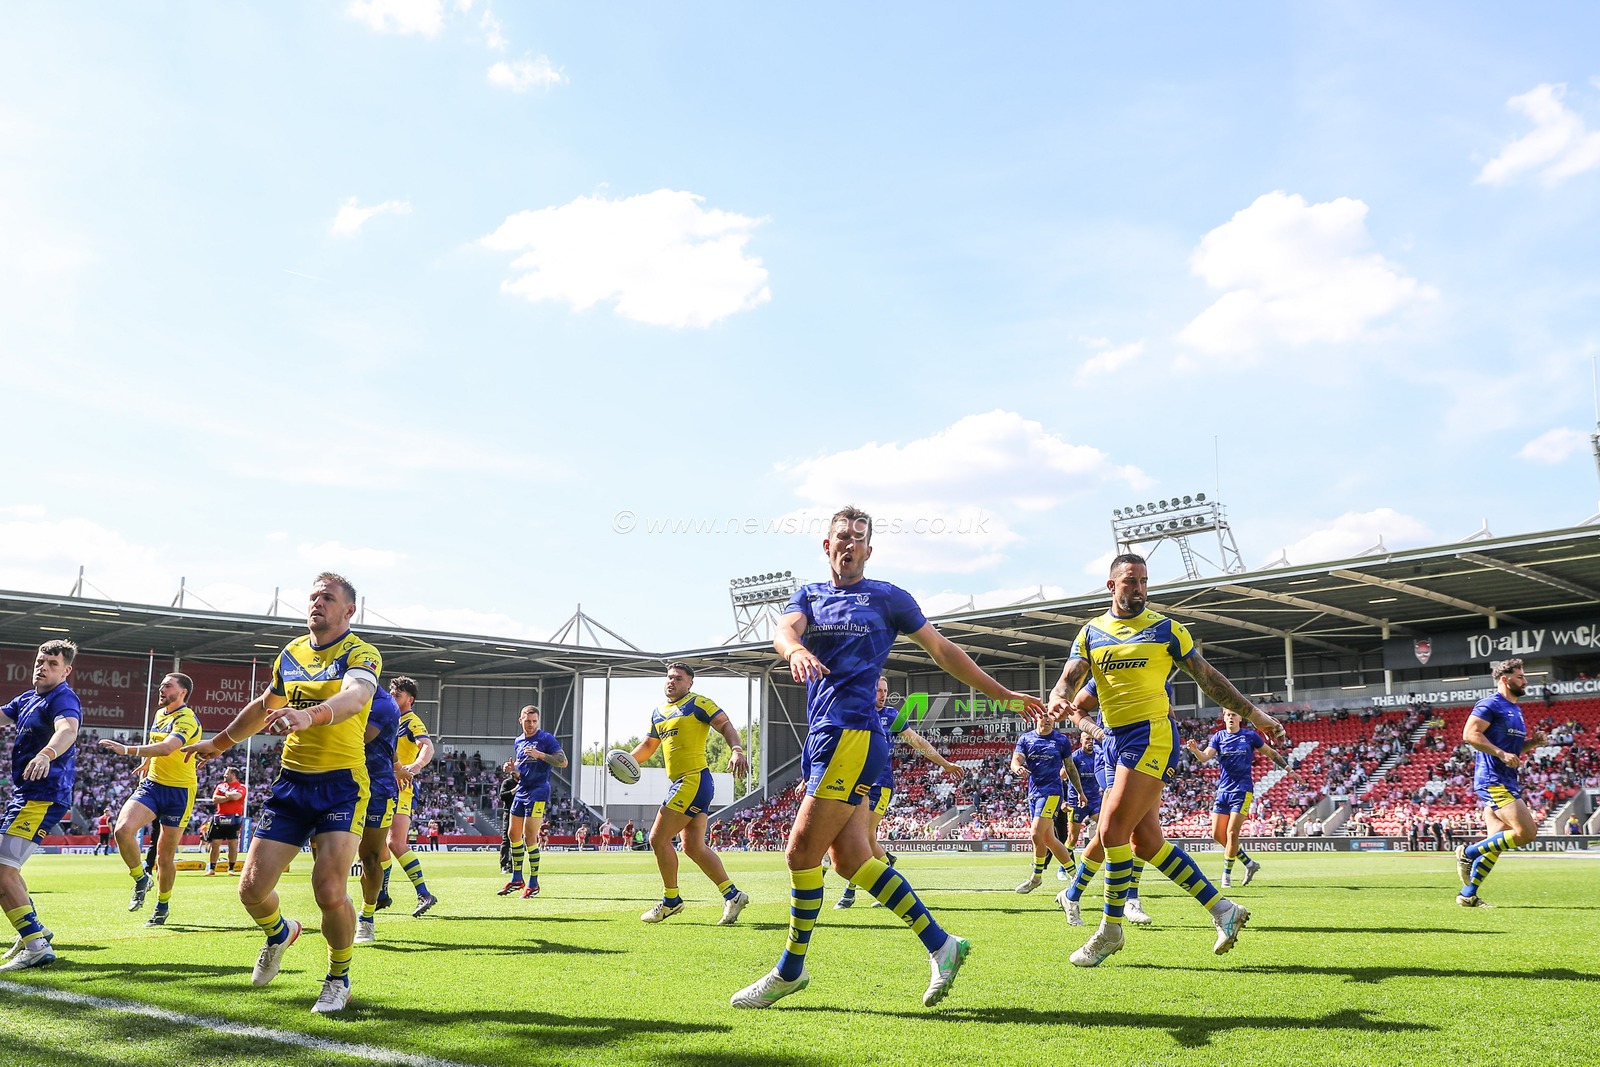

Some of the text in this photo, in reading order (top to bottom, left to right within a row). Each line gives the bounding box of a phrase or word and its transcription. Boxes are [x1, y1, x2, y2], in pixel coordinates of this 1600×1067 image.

[850, 623, 870, 632] Park
[1098, 650, 1149, 673] HOOVER
[221, 679, 245, 690] BUY
[206, 690, 244, 702] HOME
[1371, 695, 1395, 706] THE
[1395, 691, 1448, 705] WORLD'S
[82, 705, 124, 717] switch
[895, 843, 936, 852] CHALLENGE
[952, 843, 973, 852] FINAL
[1011, 843, 1033, 852] BETFR
[1239, 842, 1283, 852] ALLENGE
[1284, 842, 1305, 852] CUP
[1307, 842, 1337, 852] FINAL
[1546, 841, 1580, 851] FINAL
